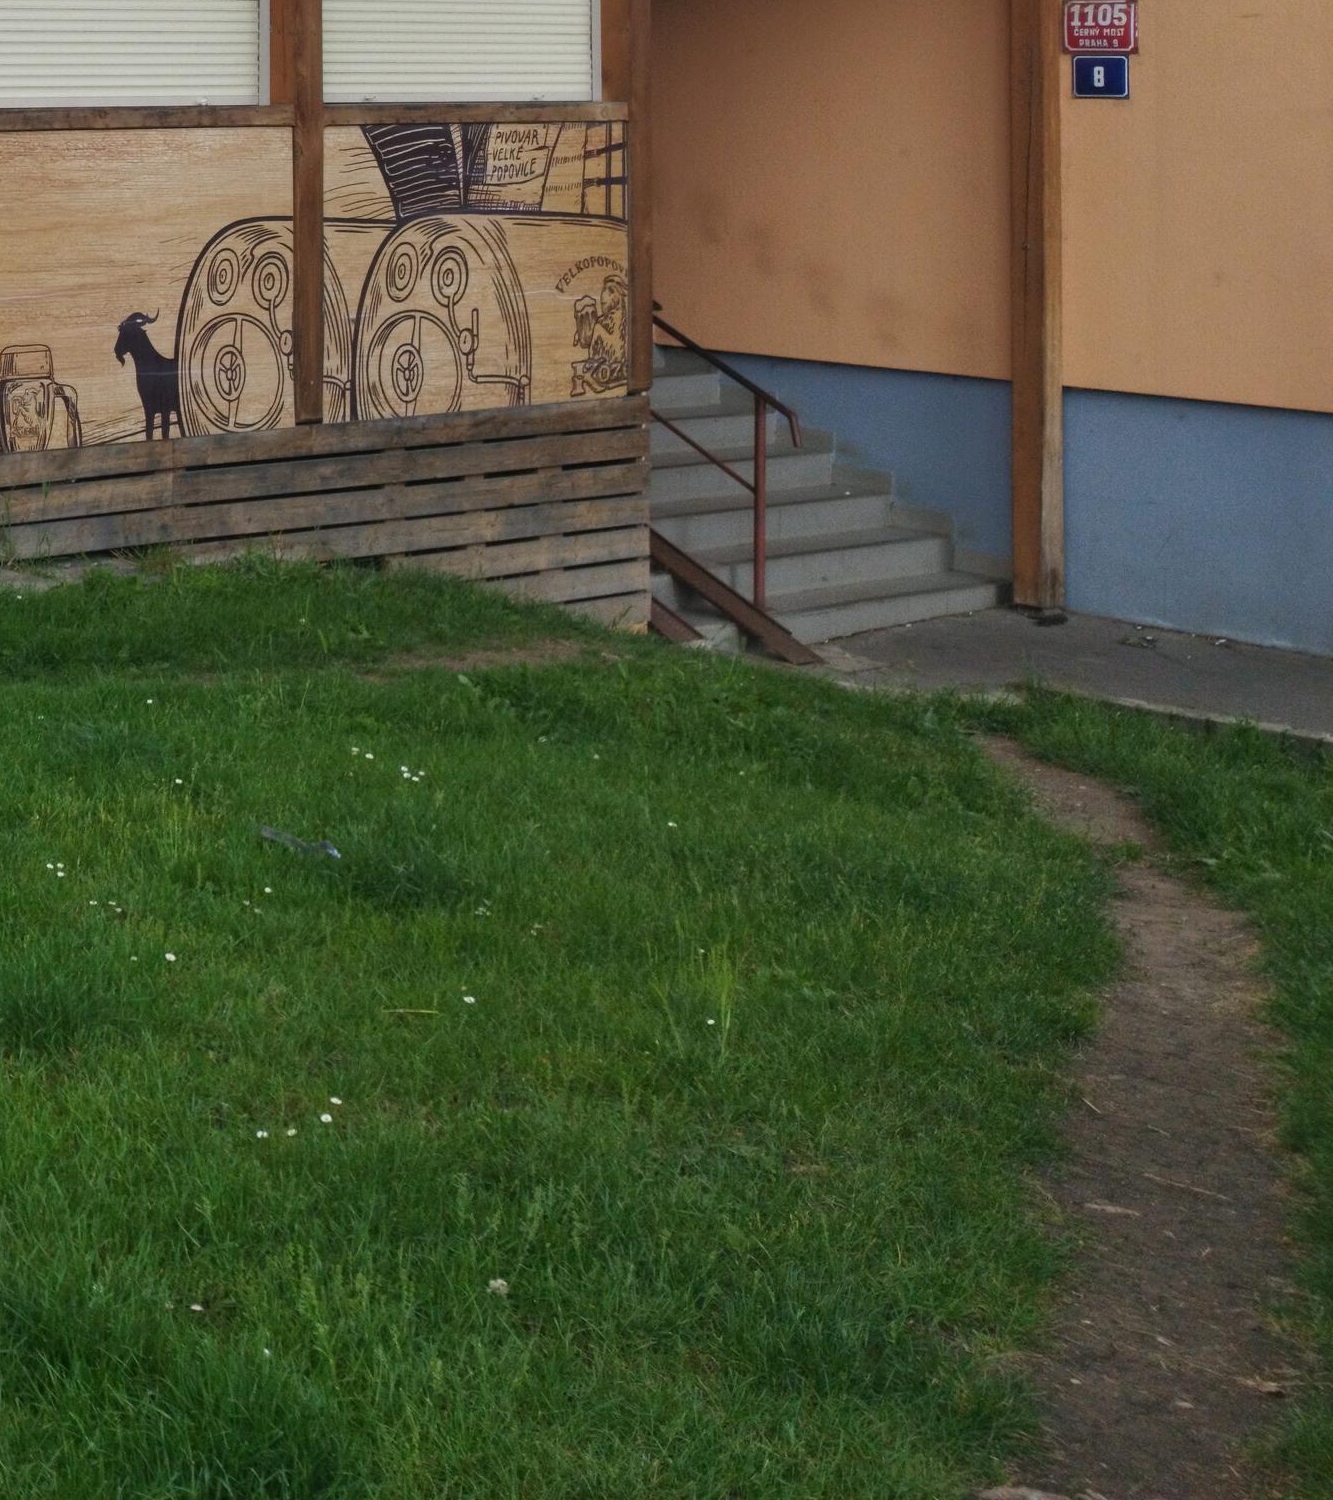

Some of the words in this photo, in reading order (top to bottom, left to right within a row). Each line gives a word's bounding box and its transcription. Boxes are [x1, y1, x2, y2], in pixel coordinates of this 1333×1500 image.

[1070, 4, 1127, 26] 1105
[1074, 27, 1100, 36] ČERNÝ
[1103, 28, 1125, 36] MOST
[1079, 39, 1108, 47] PRAHA
[1113, 39, 1119, 47] 9
[1094, 66, 1104, 87] 8
[494, 129, 539, 146] PIVOVAR
[493, 145, 523, 162] VELKÉ
[491, 158, 537, 181] POPOVICE
